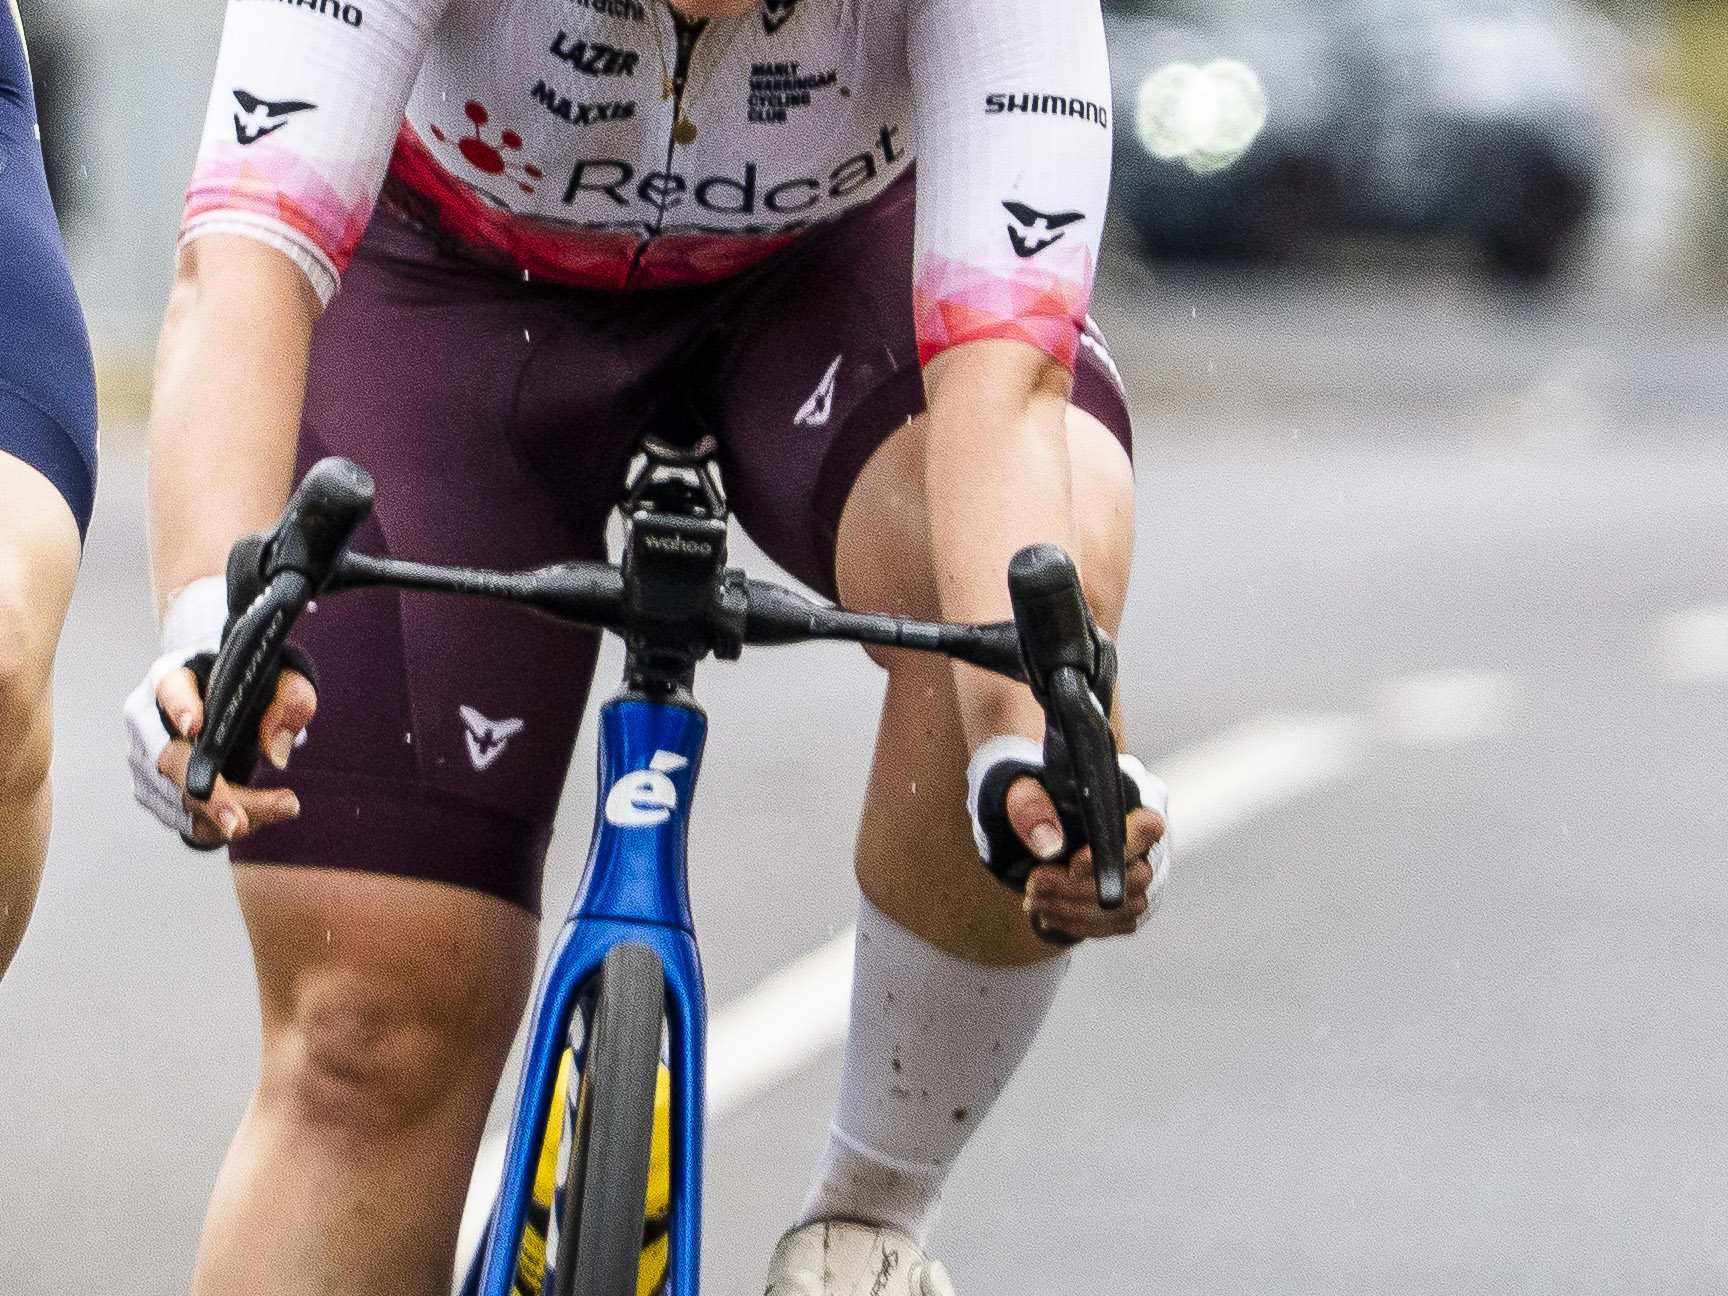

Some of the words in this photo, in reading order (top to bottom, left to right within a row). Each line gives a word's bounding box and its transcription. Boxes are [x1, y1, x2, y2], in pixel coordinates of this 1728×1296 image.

[549, 29, 640, 77] LAZER
[984, 92, 1109, 129] SHIMANO
[560, 122, 908, 216] Redcat
[645, 532, 712, 555] wahoo
